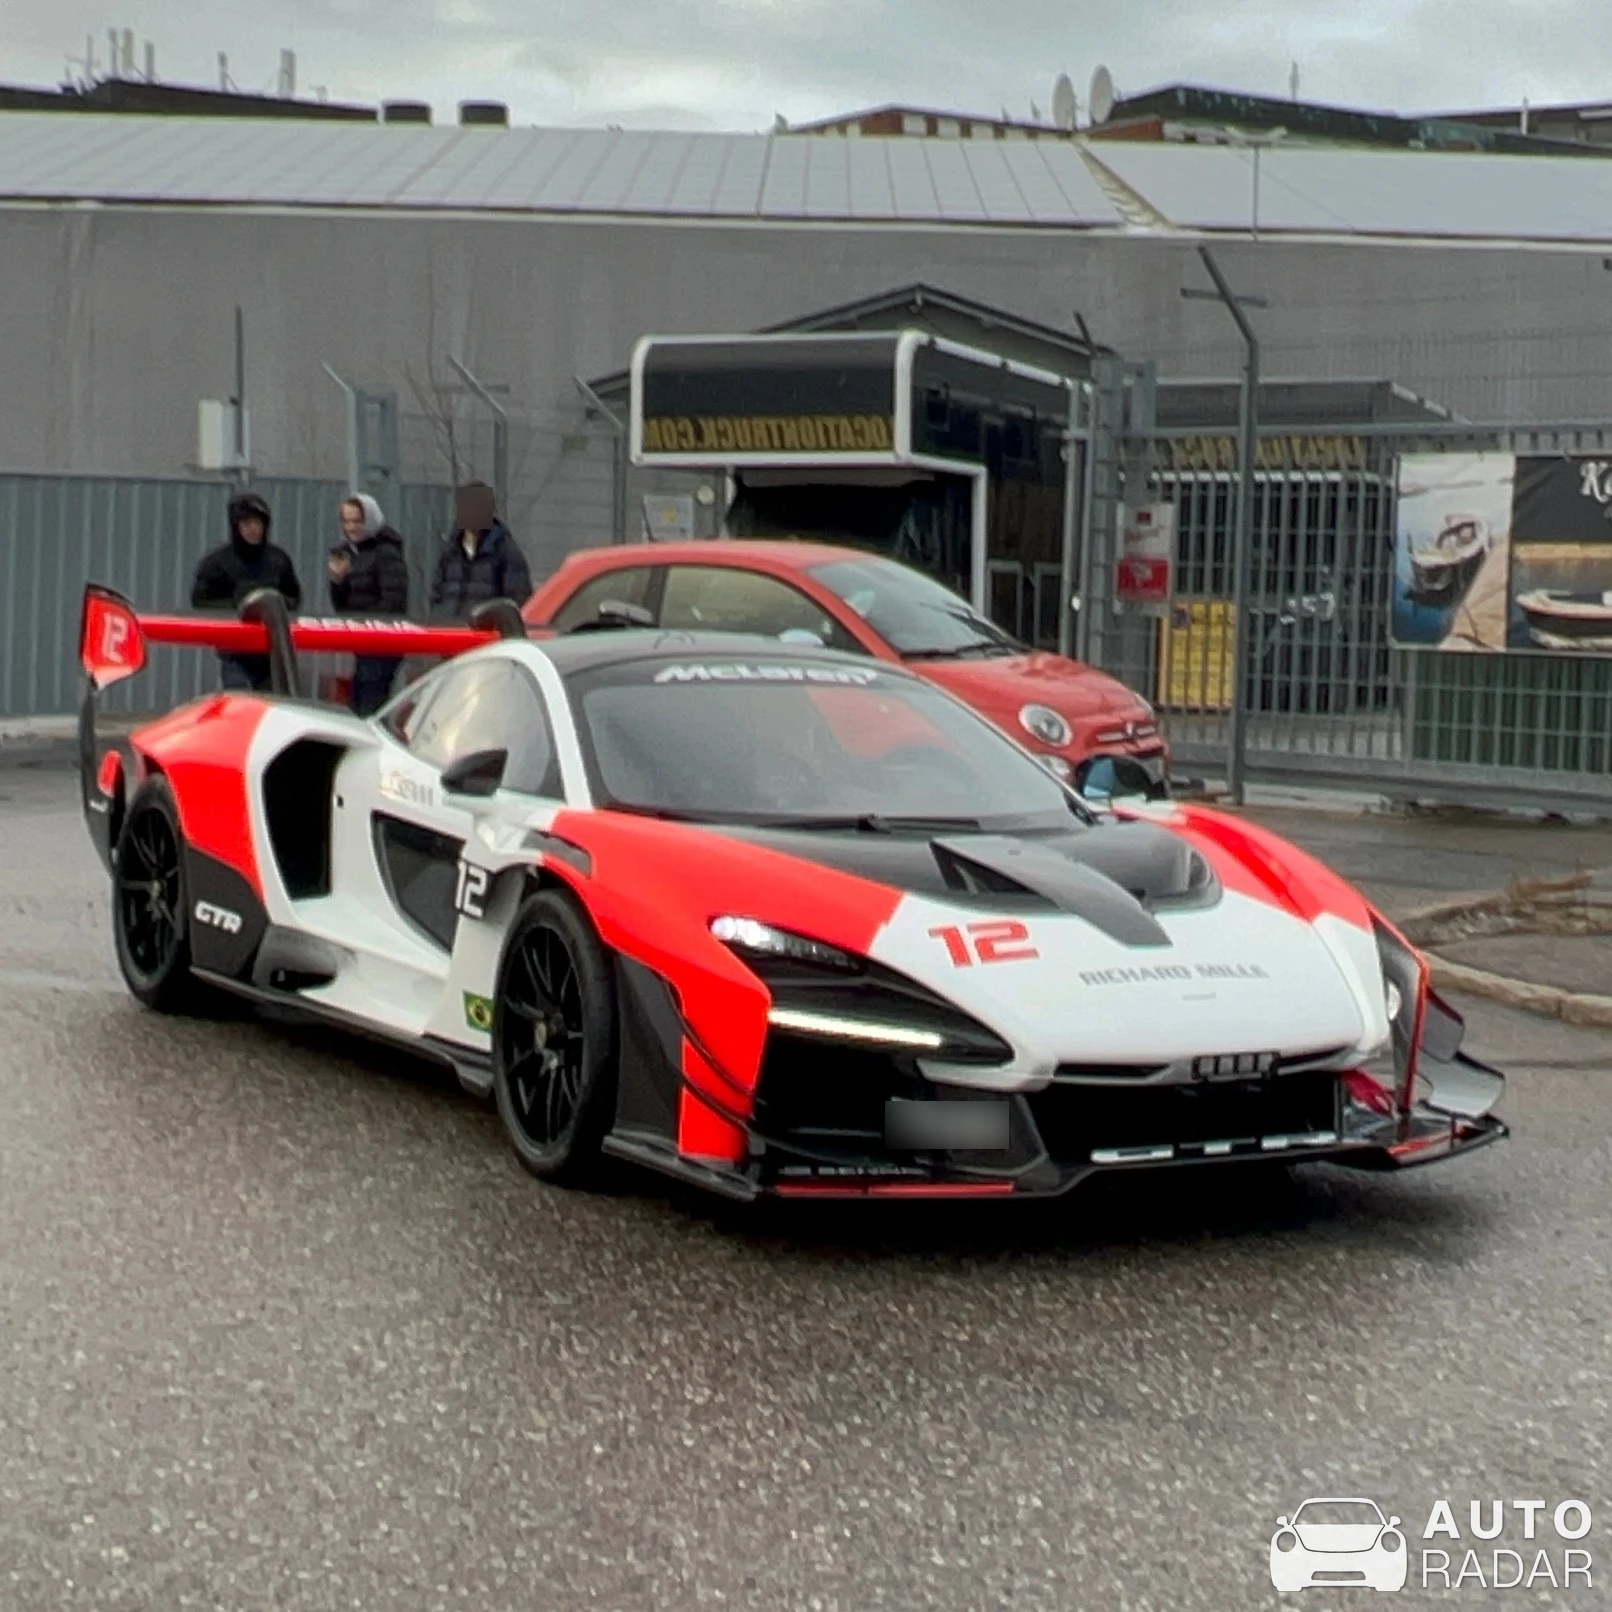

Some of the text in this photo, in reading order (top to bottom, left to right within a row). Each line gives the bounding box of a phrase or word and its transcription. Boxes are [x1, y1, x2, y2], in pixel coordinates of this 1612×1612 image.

[102, 612, 128, 664] 12
[654, 665, 877, 684] McLaren
[455, 861, 487, 918] 12
[195, 901, 242, 934] GTR
[928, 920, 1040, 968] 12
[1079, 963, 1271, 987] RICHARD MILLE
